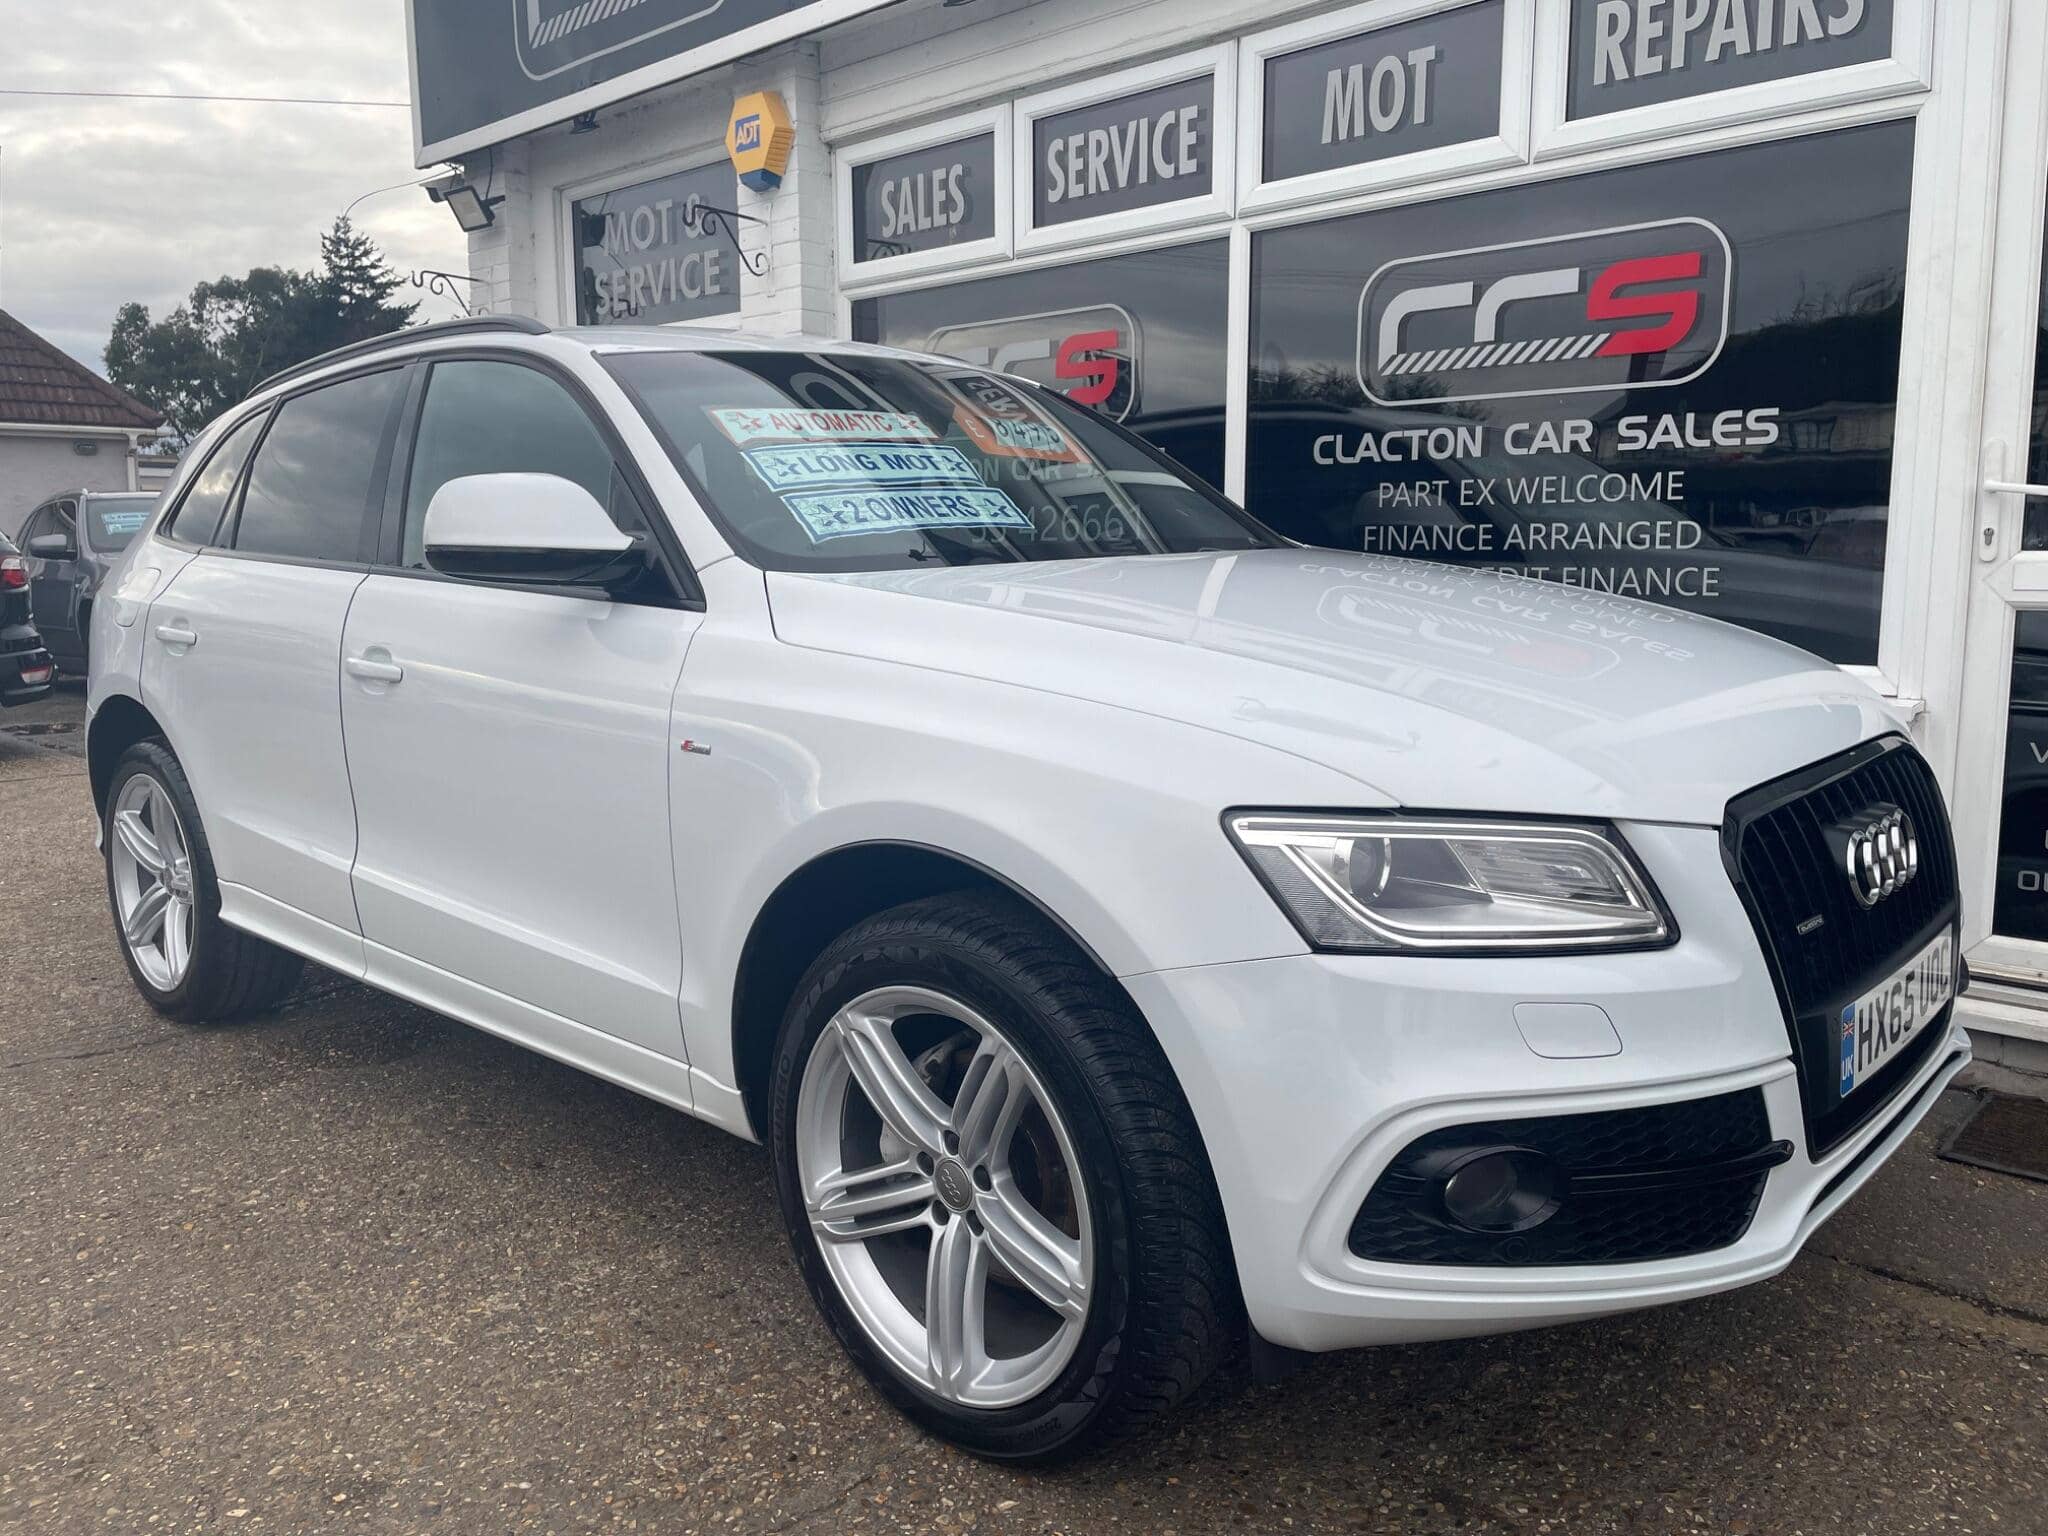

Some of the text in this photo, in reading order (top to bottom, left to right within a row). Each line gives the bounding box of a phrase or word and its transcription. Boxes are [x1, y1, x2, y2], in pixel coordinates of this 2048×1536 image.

[1321, 45, 1437, 145] MOT
[735, 120, 760, 148] ADT
[1046, 105, 1199, 205] SERVICE
[881, 163, 966, 239] SALES
[603, 198, 673, 257] MOT
[595, 248, 721, 316] SERVICE
[770, 411, 893, 433] AUTOMATIC
[1313, 407, 1780, 465] CLACTON CAR SALES
[797, 451, 937, 474] LONG MOT
[842, 493, 979, 523] 2 OWNERS
[1378, 470, 1685, 508] PART EX WELCOME
[1363, 519, 1702, 551] FINANCE ARRANGED
[1562, 566, 1721, 597] FINANCE
[1857, 969, 1916, 1073] HX65
[1841, 1054, 1854, 1081] UK
